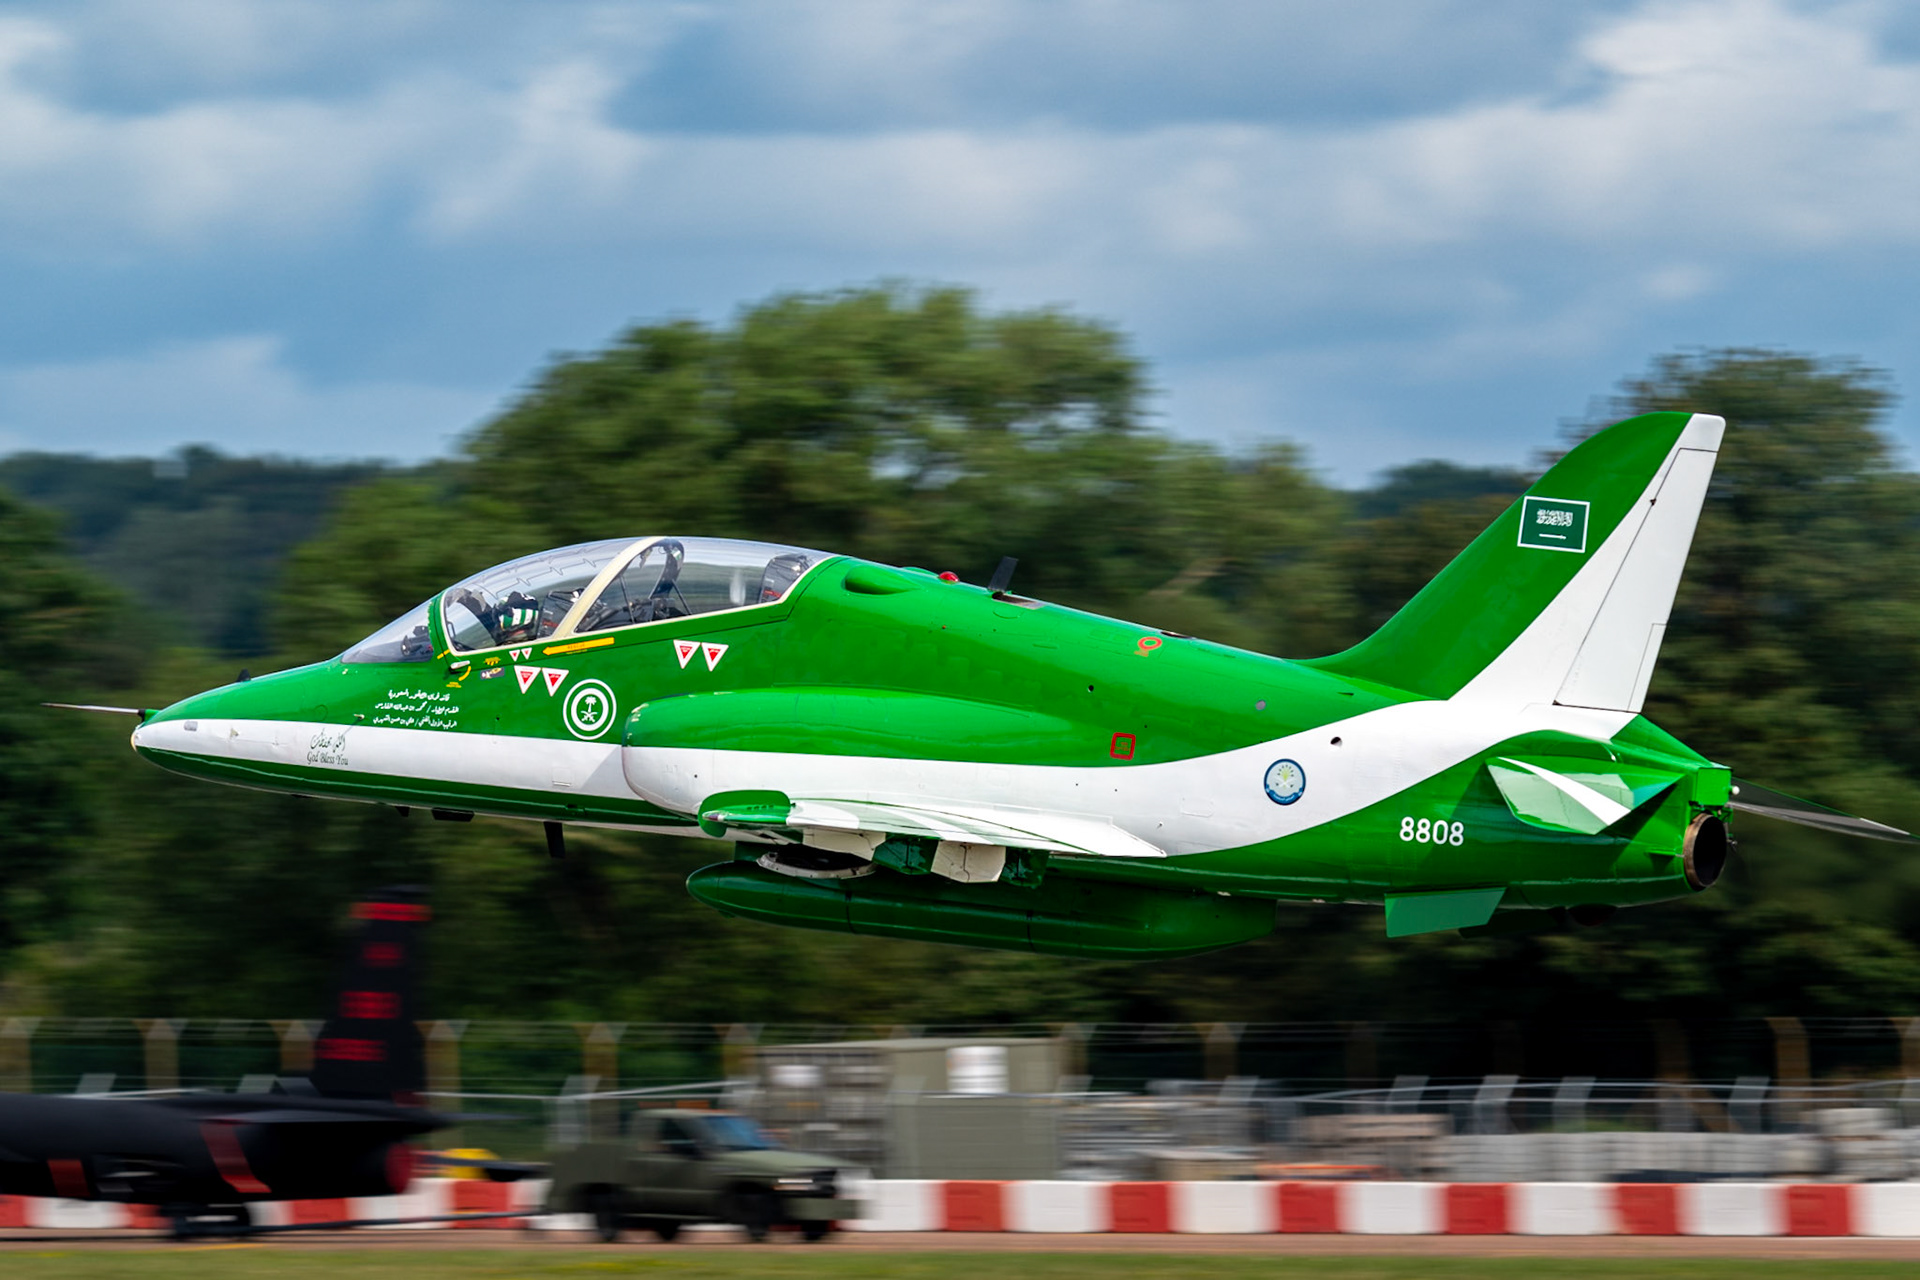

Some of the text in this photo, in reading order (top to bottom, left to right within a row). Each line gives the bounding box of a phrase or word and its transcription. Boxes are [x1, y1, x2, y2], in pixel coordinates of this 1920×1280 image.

[307, 751, 349, 766] God Bless You
[1399, 816, 1464, 846] 8808
